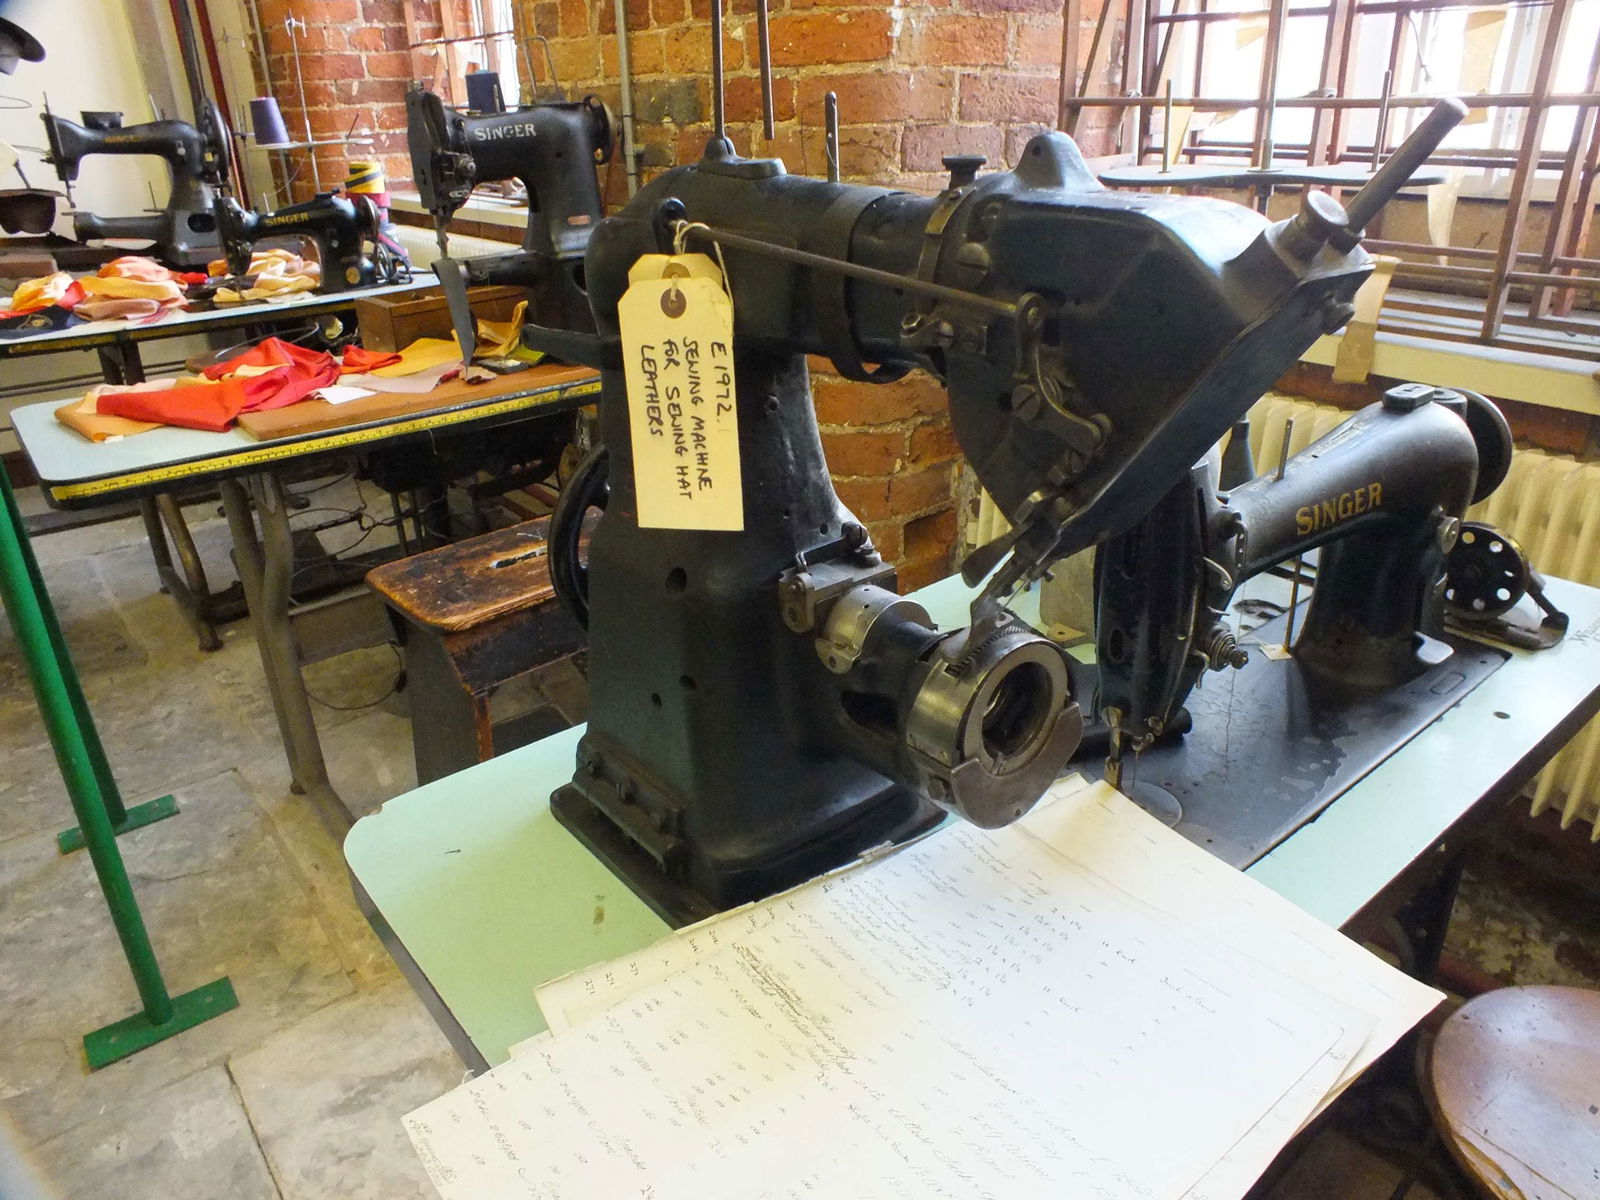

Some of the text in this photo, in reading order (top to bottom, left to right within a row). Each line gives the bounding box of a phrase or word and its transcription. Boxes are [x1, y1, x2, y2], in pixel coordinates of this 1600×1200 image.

[474, 123, 537, 141] SINGER
[264, 211, 310, 227] SINGER
[711, 341, 728, 359] E
[641, 344, 664, 437] LEATHERS
[683, 336, 713, 491] SEWING MACHINE
[663, 338, 692, 500] FOR SEWING HAT
[1295, 481, 1384, 536] SINGER
